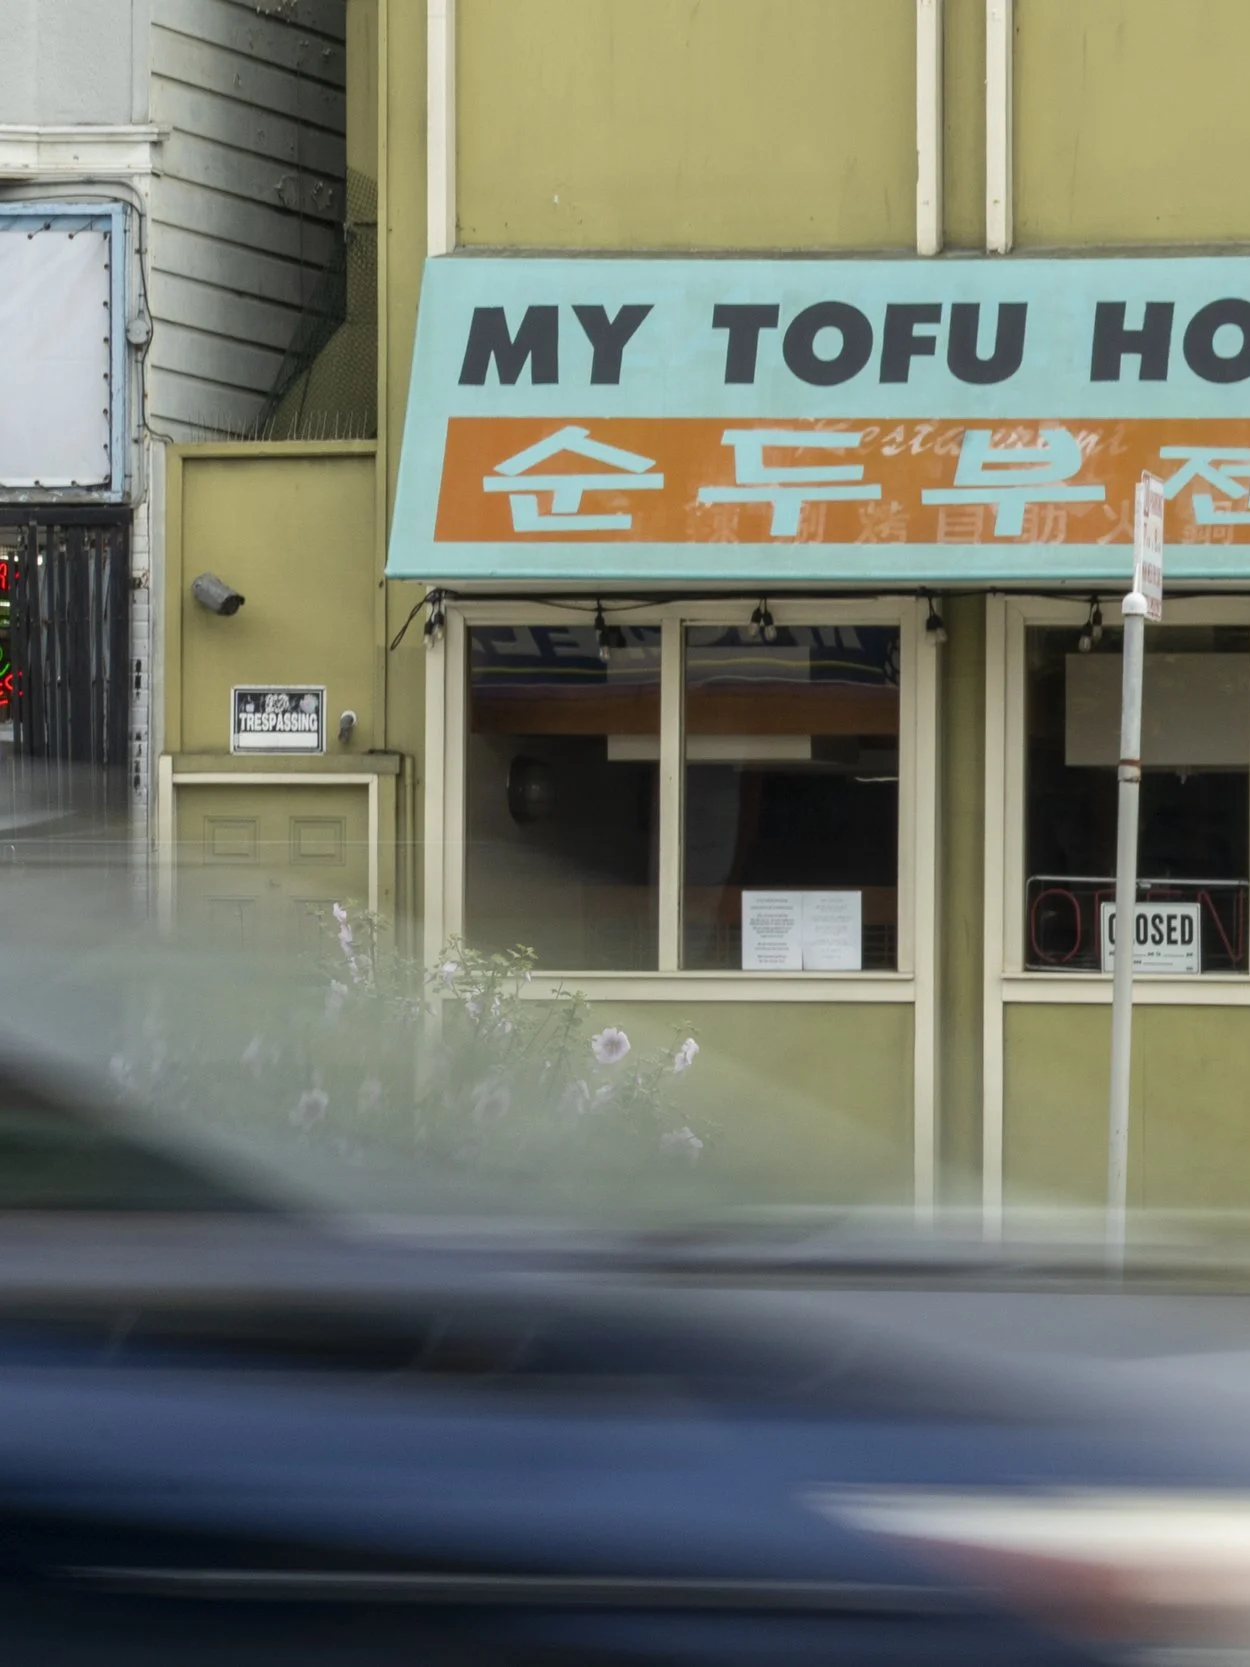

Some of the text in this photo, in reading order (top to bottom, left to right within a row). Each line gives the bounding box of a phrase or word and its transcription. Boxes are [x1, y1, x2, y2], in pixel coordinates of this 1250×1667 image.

[458, 304, 655, 386] MY
[712, 301, 1028, 386] TOFU
[239, 712, 318, 732] TRESPASSING
[1107, 912, 1194, 947] COSED
